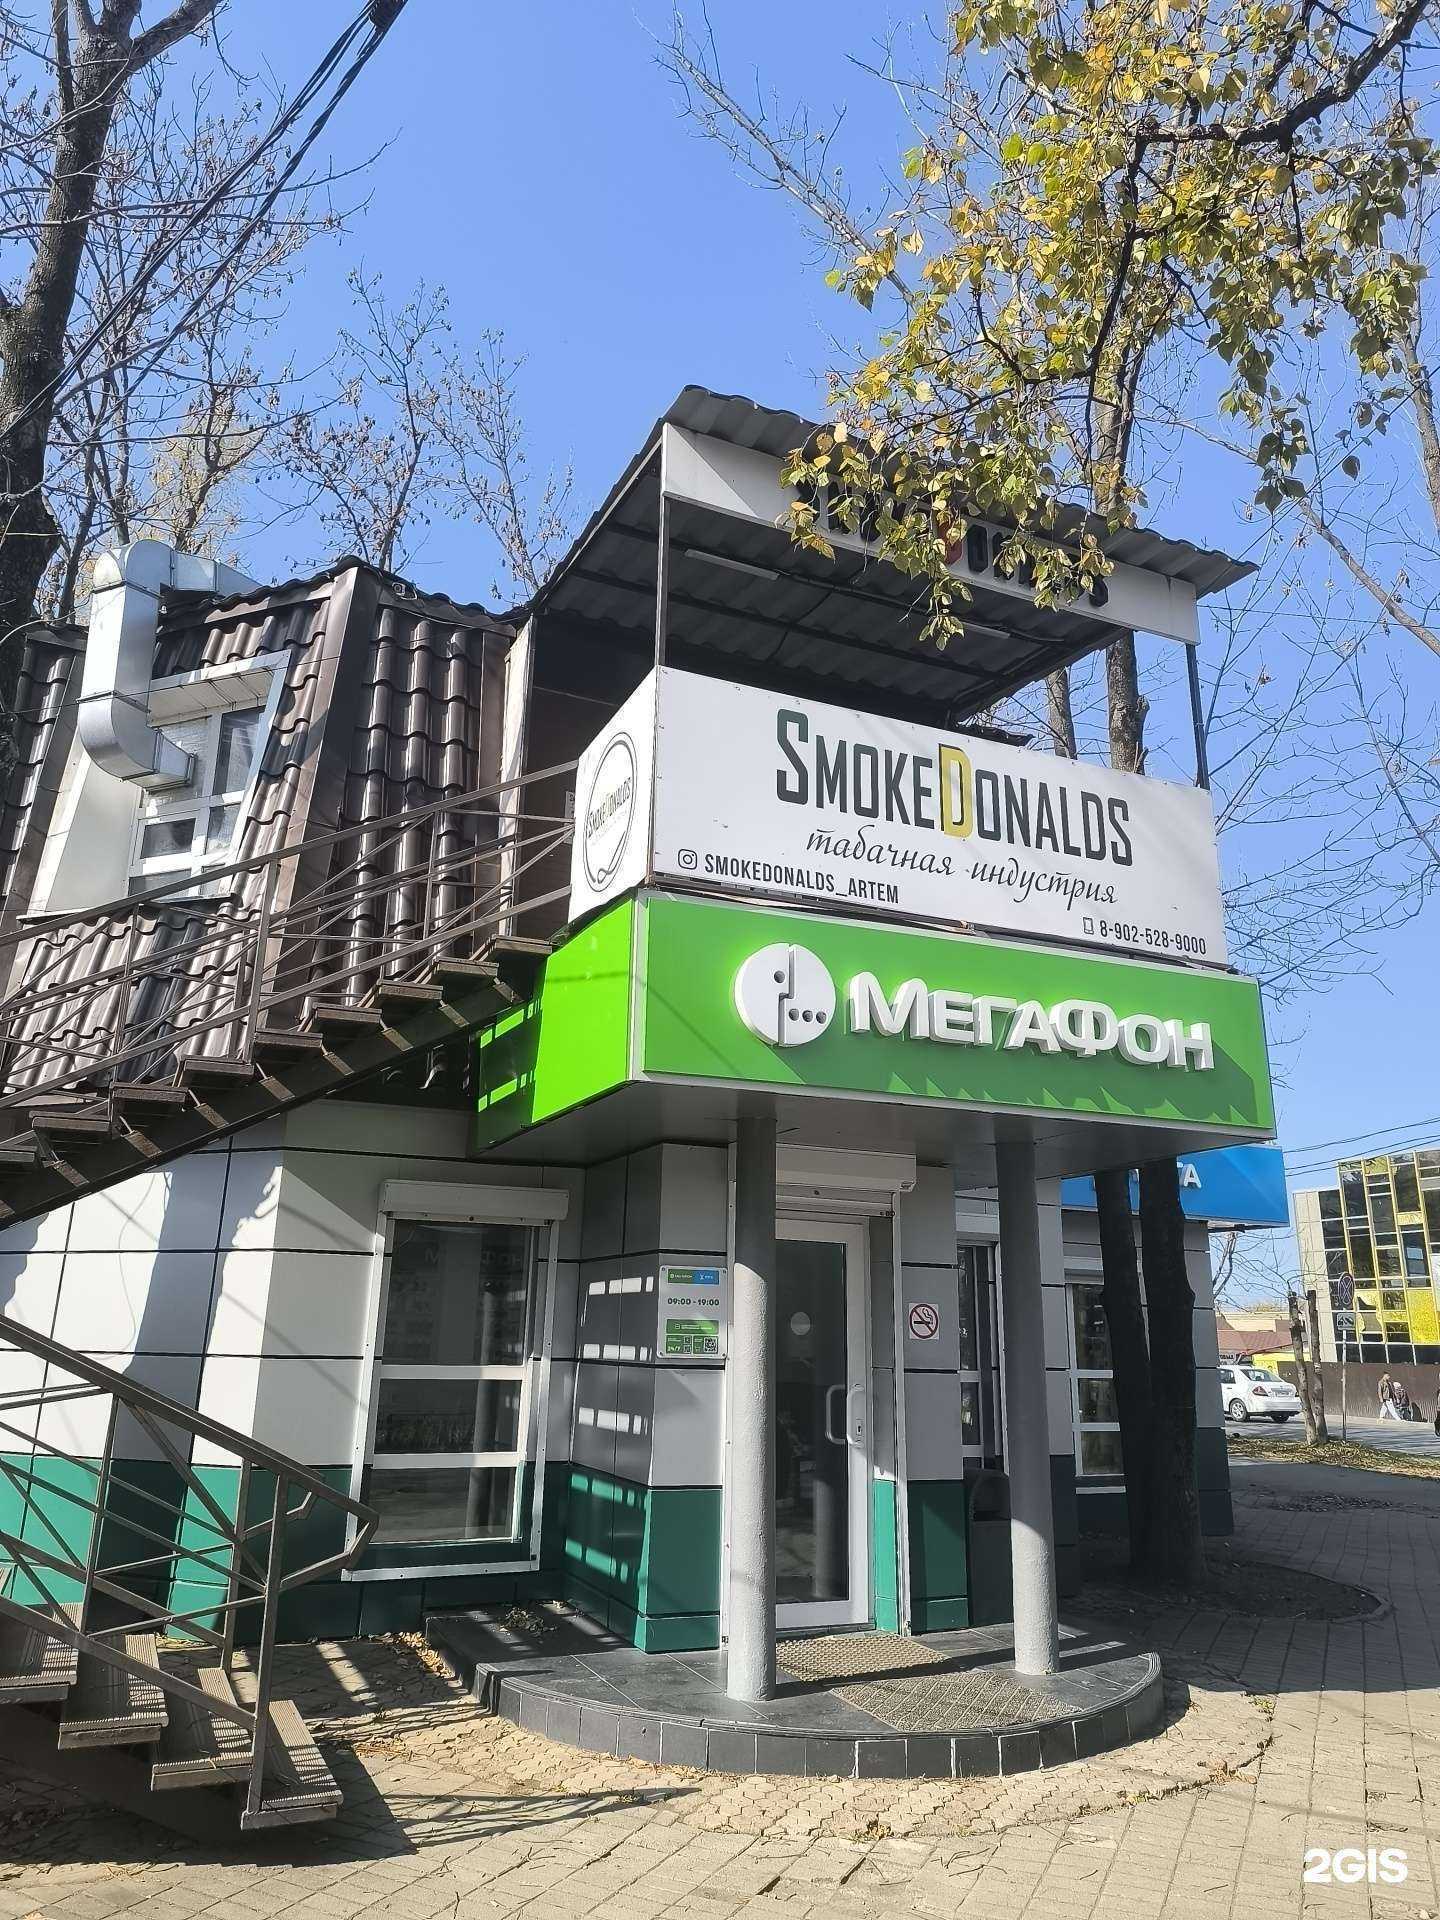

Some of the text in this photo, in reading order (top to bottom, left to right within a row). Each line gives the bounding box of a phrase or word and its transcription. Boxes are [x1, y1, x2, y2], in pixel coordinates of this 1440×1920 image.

[776, 707, 1133, 867] SMOKEDONALDS
[704, 853, 900, 904] SMOKEDONALDS_ARTEM
[805, 823, 1119, 911] табачная индустрия
[1099, 919, 1207, 955] 8-902-528-9000
[848, 971, 1215, 1071] МЕГАФОН
[667, 1297, 692, 1305] 09:00
[697, 1298, 720, 1306] 19:00
